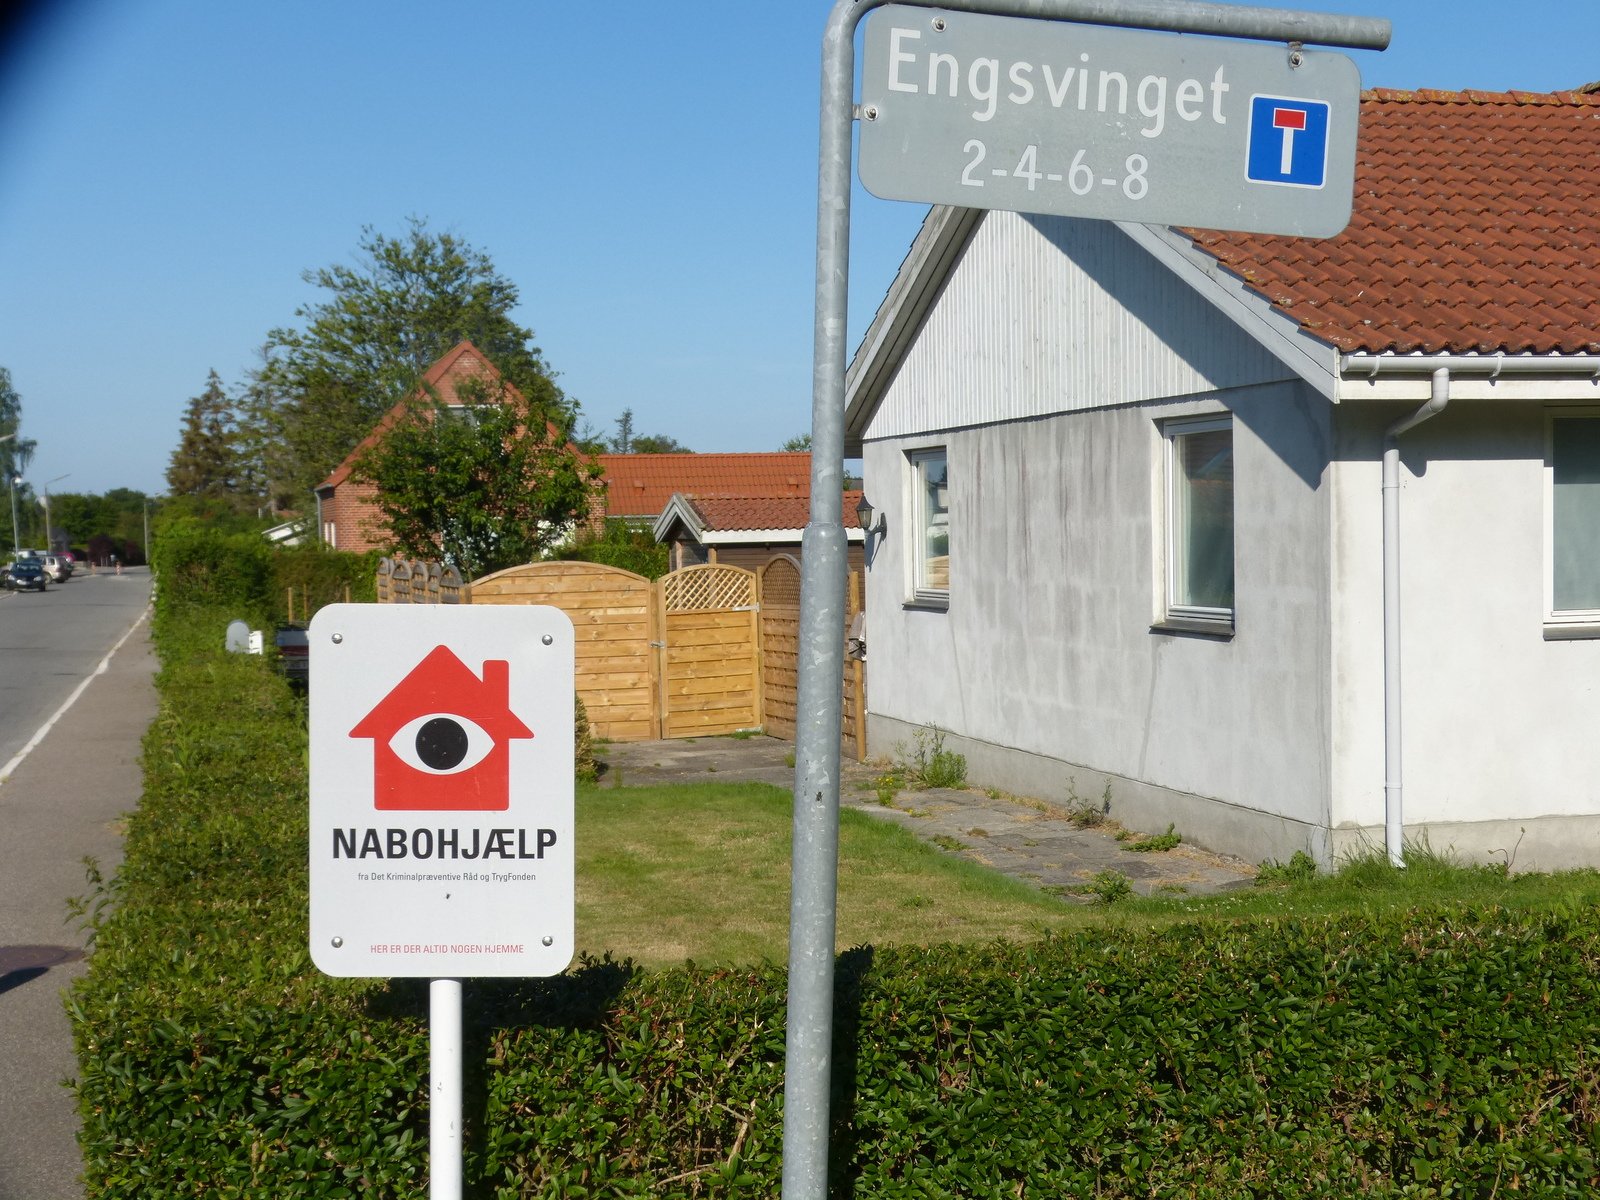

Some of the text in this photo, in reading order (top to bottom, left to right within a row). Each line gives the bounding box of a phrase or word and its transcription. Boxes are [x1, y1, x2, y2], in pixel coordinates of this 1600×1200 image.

[887, 27, 1230, 138] Engsvinget
[960, 138, 1149, 200] 2-4-6-8
[332, 828, 557, 860] NABOHJÆLP
[358, 871, 536, 883] fra Det Kriminalpræventive Råd og TrygFonden
[370, 945, 524, 954] HER ER DER ALTID NOGEN HJEMME
